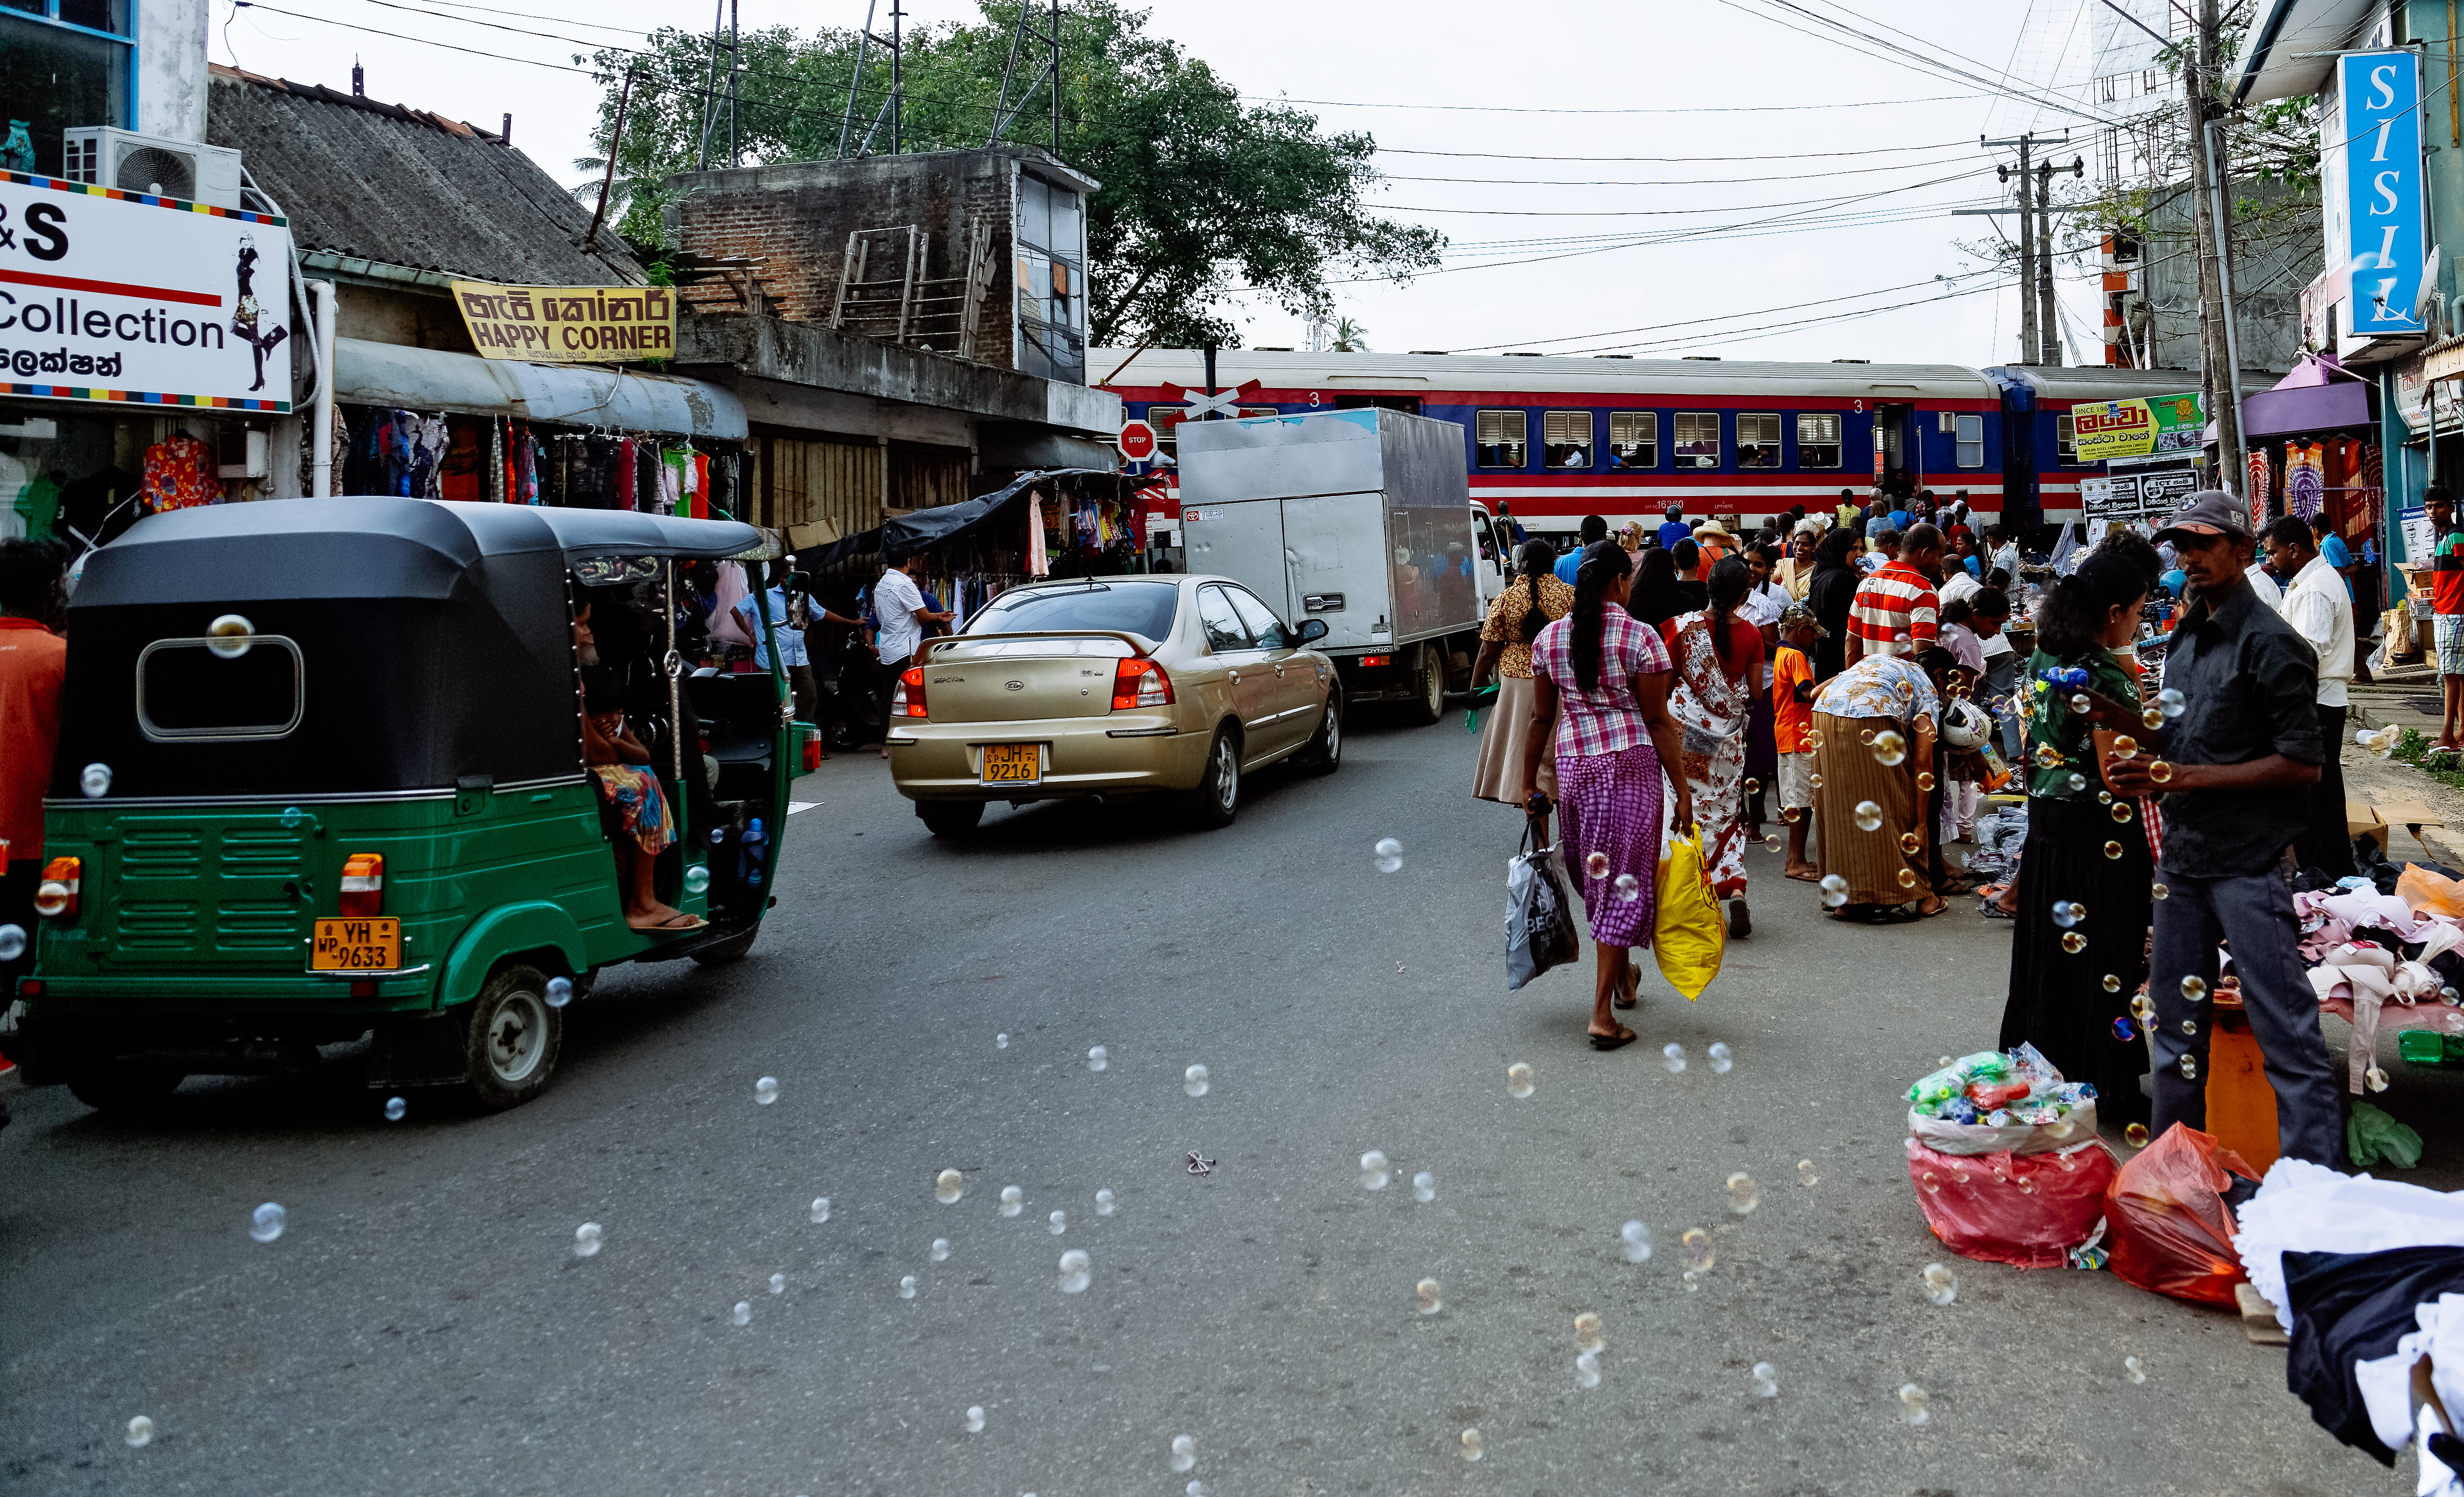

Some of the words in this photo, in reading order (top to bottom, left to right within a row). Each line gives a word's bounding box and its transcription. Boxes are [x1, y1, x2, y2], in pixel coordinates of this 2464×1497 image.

[2366, 65, 2407, 322] SISIL
[472, 322, 550, 349] HAPPY
[562, 325, 671, 350] CORNER
[1309, 392, 1320, 407] 3
[1854, 399, 1863, 414] 3
[2075, 407, 2094, 415] SINCE
[1000, 745, 1022, 762] JH
[990, 763, 1031, 780] 9216
[319, 937, 337, 953] WP
[344, 922, 370, 943] YH
[339, 946, 386, 968] 9633
